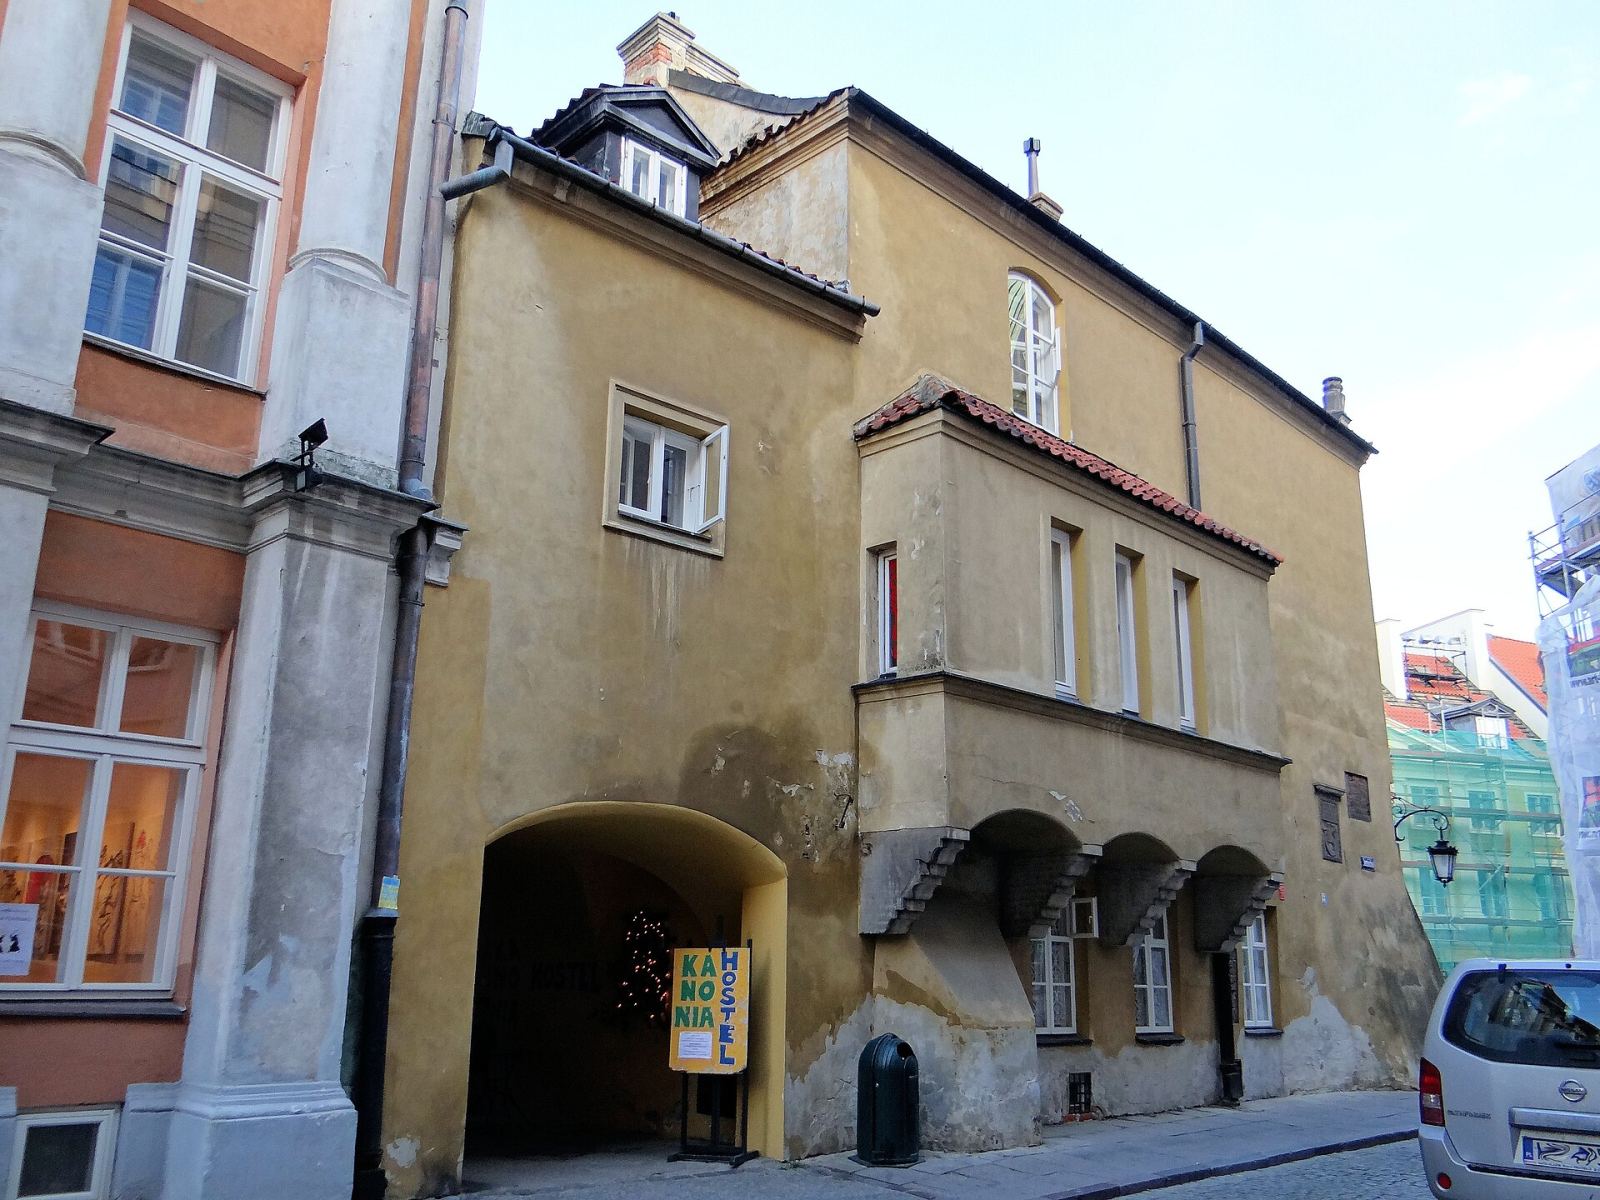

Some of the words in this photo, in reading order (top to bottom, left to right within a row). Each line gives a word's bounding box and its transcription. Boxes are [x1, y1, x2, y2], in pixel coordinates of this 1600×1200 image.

[682, 954, 717, 977] KA
[680, 979, 716, 1002] NO
[674, 1005, 715, 1028] NIA
[719, 951, 739, 1066] HOSTEL
